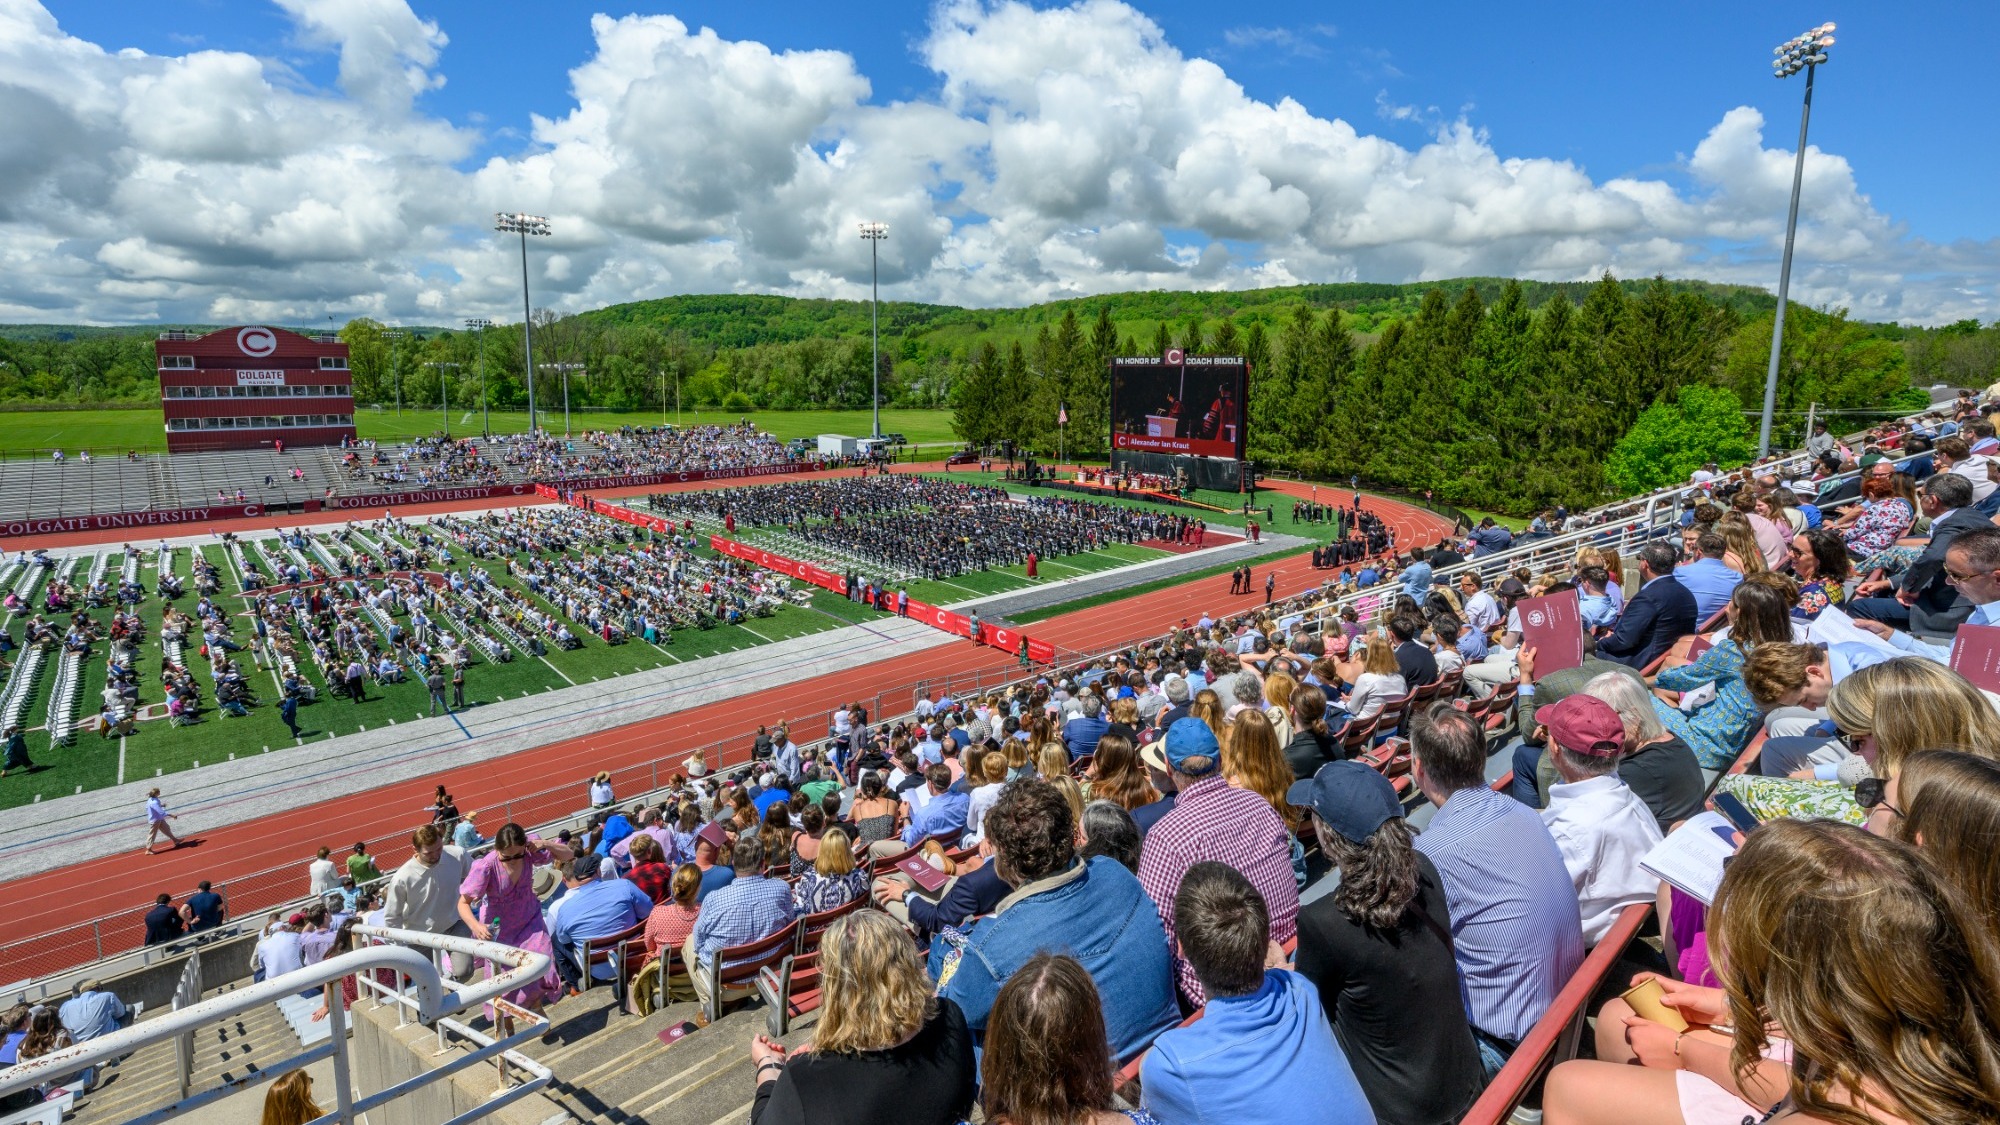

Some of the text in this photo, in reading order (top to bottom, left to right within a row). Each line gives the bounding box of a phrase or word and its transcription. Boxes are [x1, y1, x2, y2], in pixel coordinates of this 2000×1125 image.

[242, 331, 271, 353] C
[1167, 349, 1180, 364] C
[238, 371, 282, 380] COLGATE
[1118, 436, 1126, 446] C
[1130, 438, 1160, 447] Alexander
[1172, 441, 1190, 449] Kraut
[680, 473, 688, 481] C
[704, 464, 799, 479] COLGATE UNIVERSITY
[599, 475, 663, 487] UNIVERSITY
[512, 485, 523, 495] C
[339, 488, 491, 508] COLGATE UNIVERSITY
[244, 506, 258, 516] C
[0, 508, 210, 536] COLGATE UNIVERSITY
[798, 565, 806, 576] C
[885, 593, 893, 605] C
[937, 611, 946, 624] C
[997, 630, 1007, 644] C
